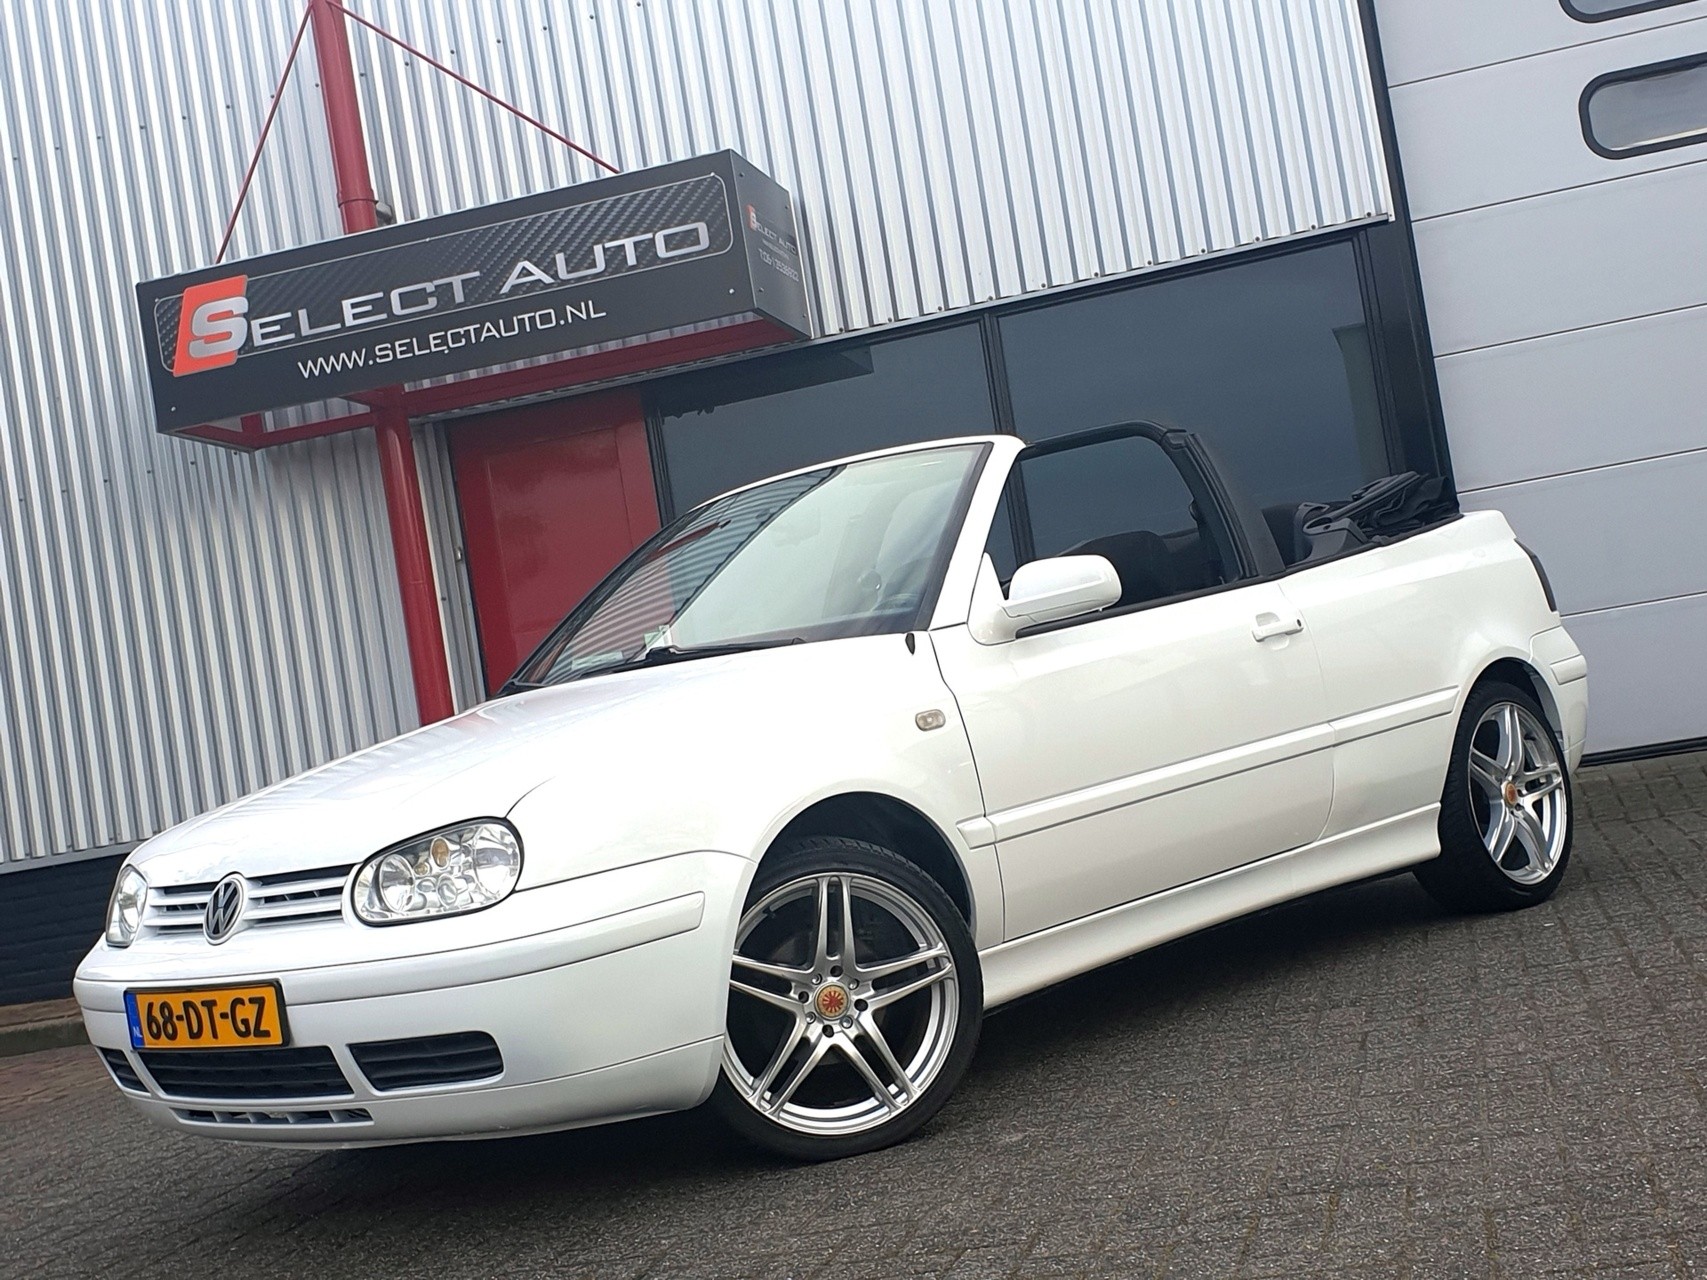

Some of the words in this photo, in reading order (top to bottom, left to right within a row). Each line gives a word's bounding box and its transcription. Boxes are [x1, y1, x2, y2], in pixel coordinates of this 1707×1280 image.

[188, 271, 481, 358] SELECT
[500, 221, 711, 295] AUTO
[297, 300, 608, 379] WWW.SELECTAUTO.NL
[133, 1026, 143, 1039] NL
[146, 996, 272, 1041] 68-DT-GZ
